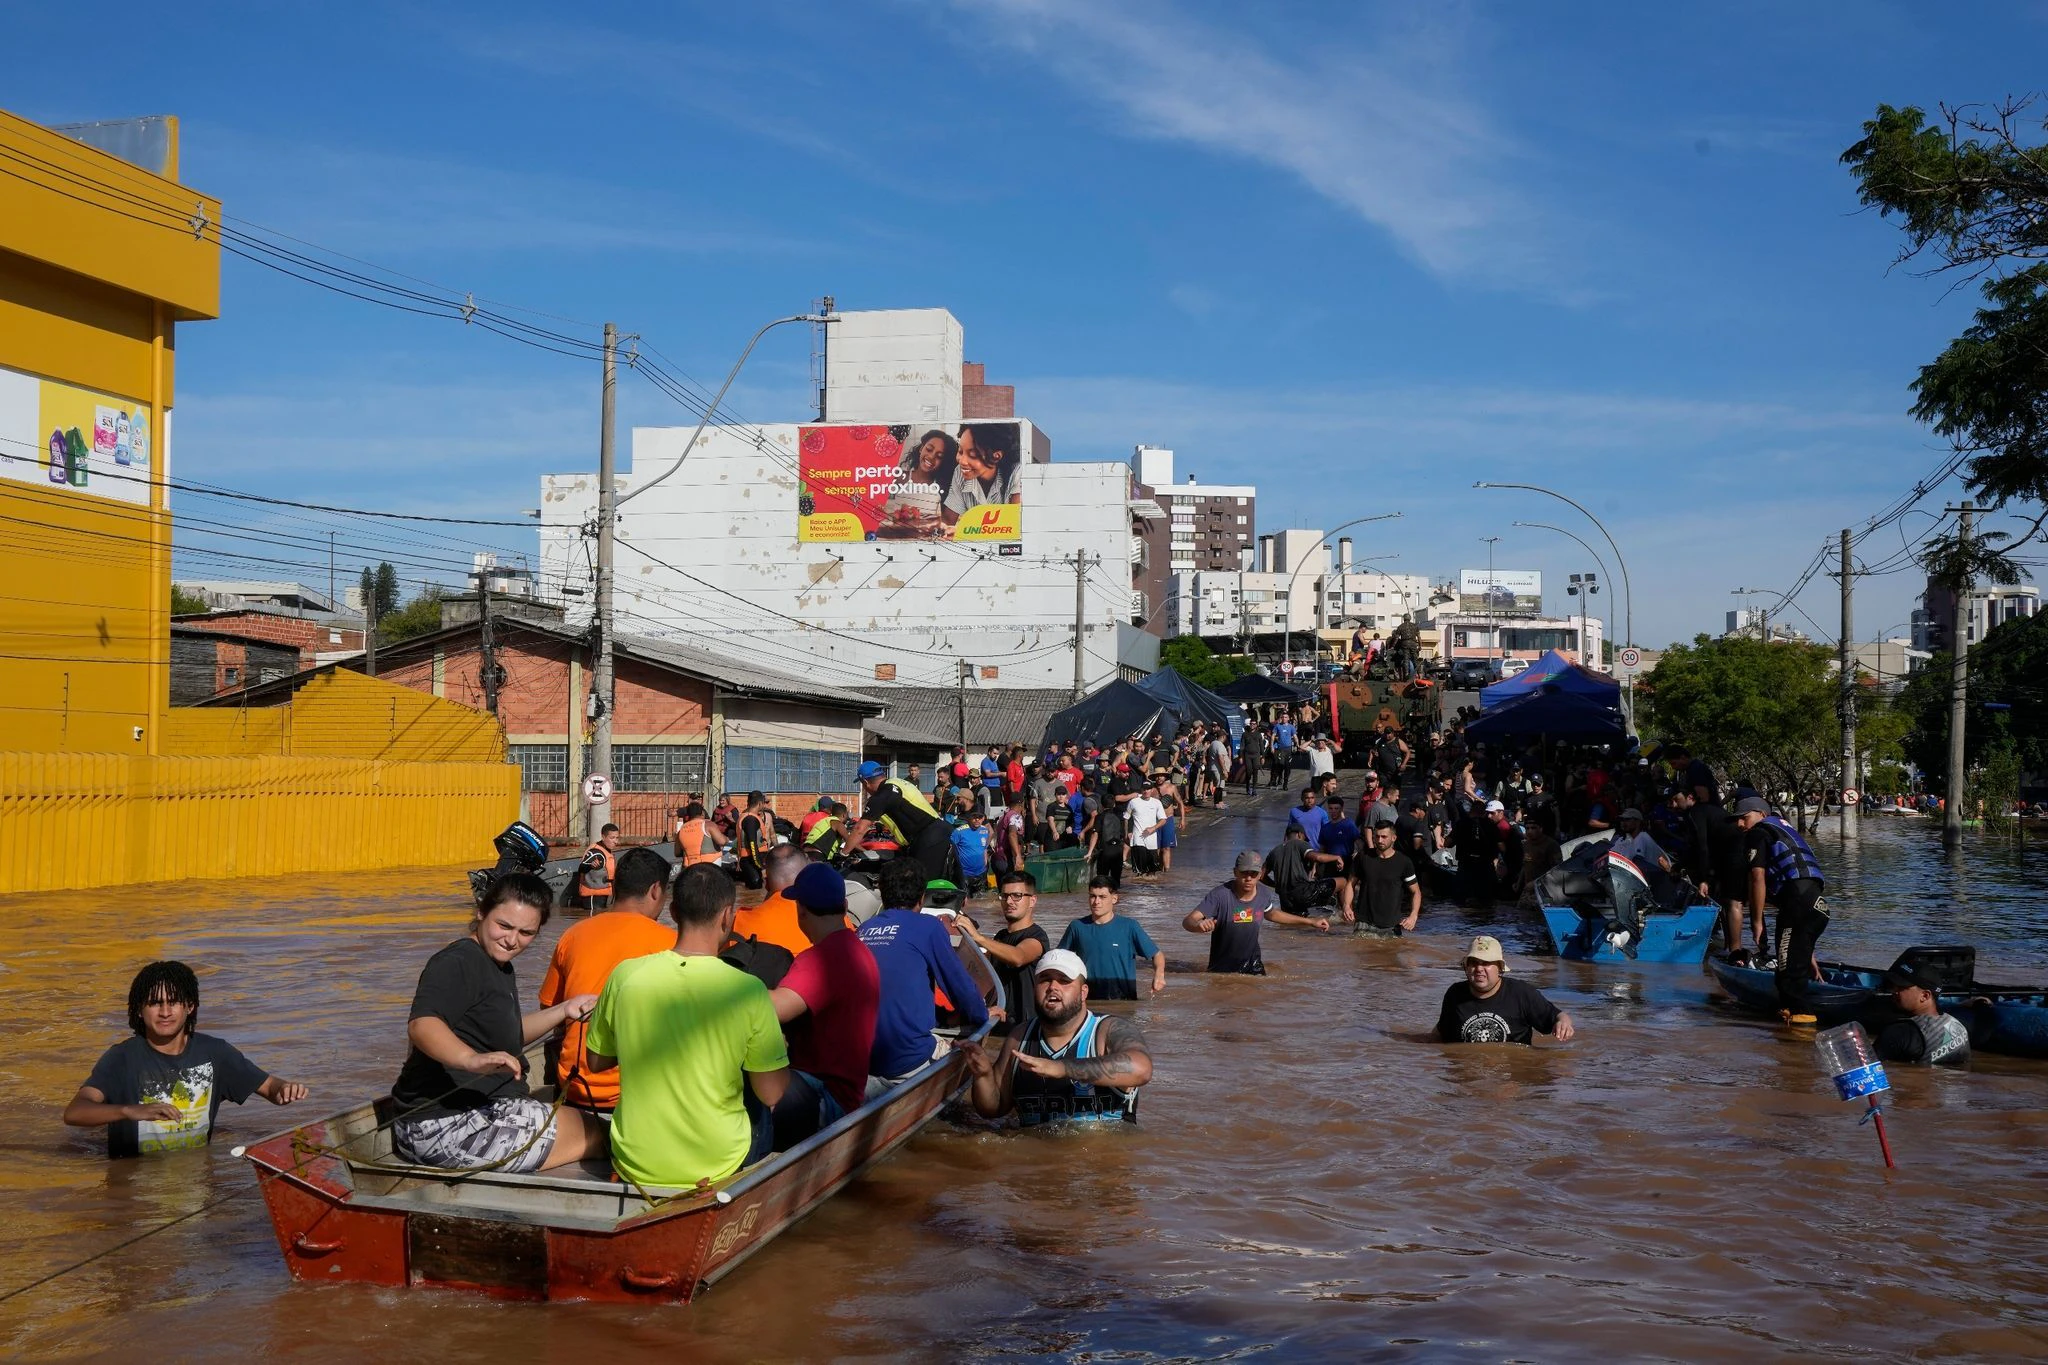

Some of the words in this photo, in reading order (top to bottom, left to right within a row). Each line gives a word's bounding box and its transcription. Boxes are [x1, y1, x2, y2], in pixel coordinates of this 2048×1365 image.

[808, 468, 852, 480] Sempre
[855, 464, 906, 482] perto,
[824, 486, 867, 497] sempre
[870, 479, 944, 499] próximo.
[711, 1224, 739, 1254] BEIRA
[741, 1209, 758, 1231] RIO
